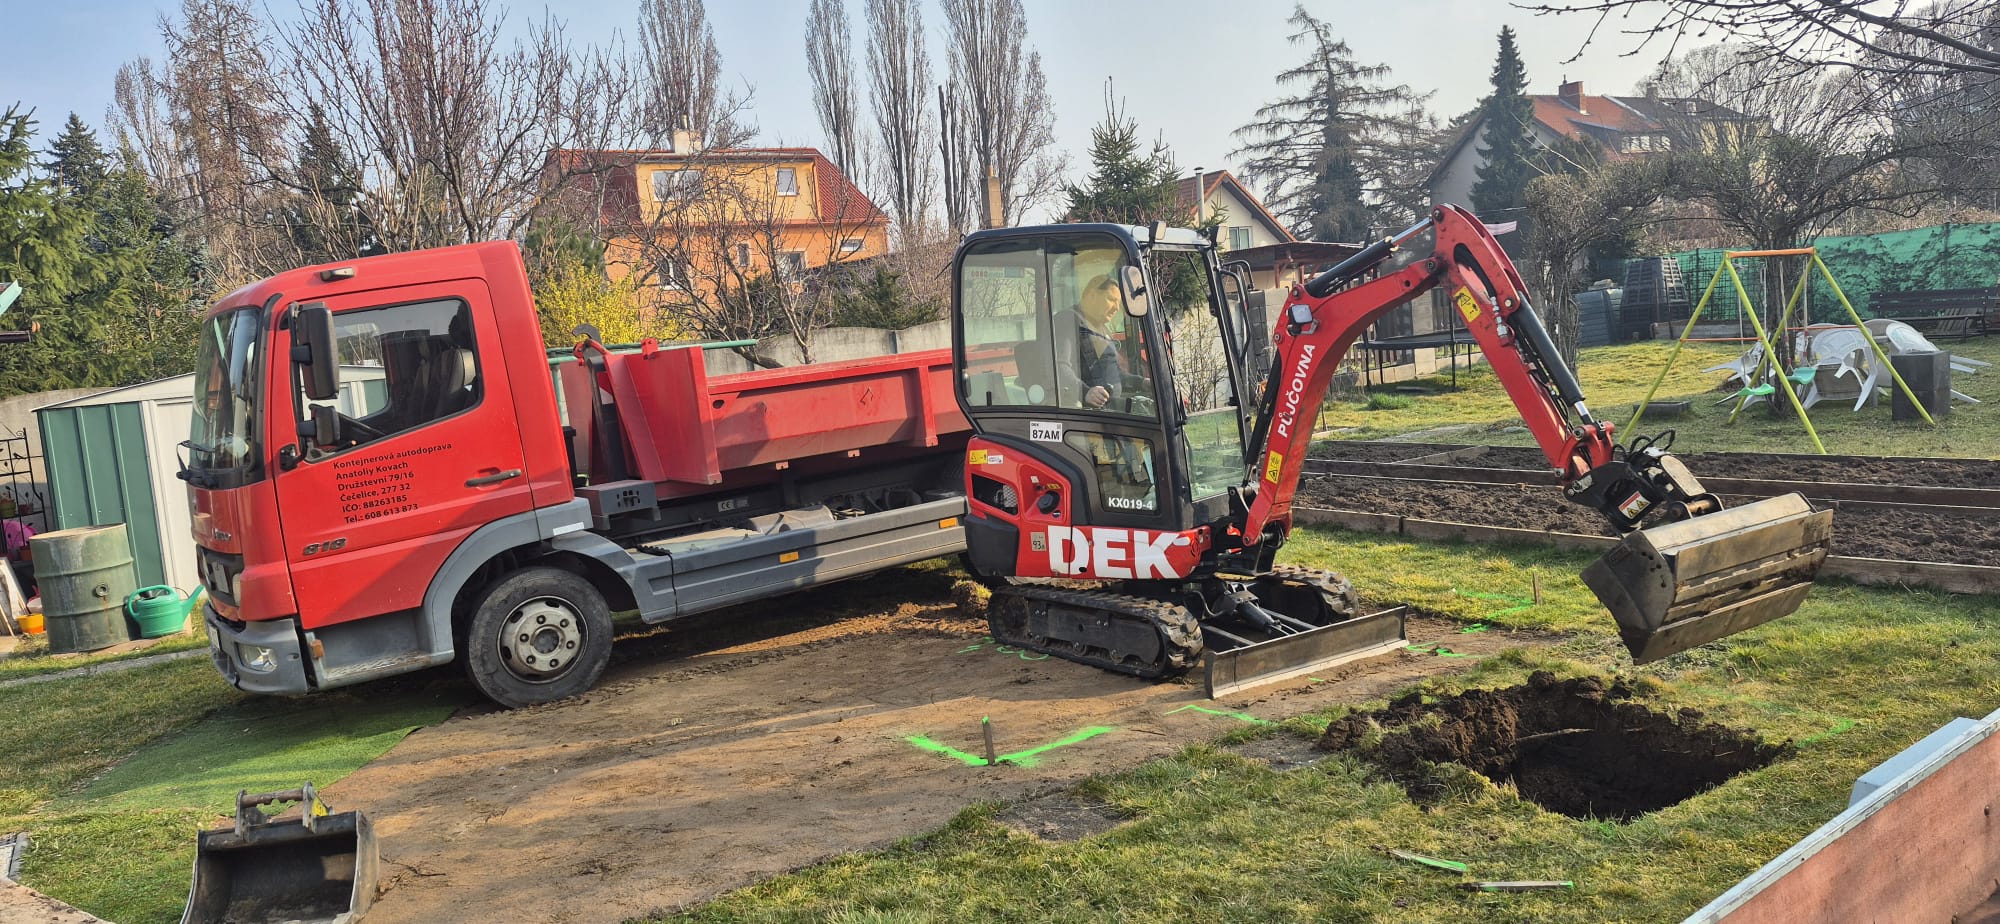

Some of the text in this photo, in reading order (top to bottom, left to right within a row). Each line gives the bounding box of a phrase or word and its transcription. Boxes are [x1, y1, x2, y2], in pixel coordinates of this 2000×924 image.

[1277, 344, 1316, 438] PŮJČOVNA
[1032, 429, 1060, 440] 87AM
[333, 443, 452, 469] Kontejnerová autodoprava
[335, 461, 409, 480] Anatoliy Kovach
[337, 471, 415, 491] Družstevní 79/16
[340, 482, 411, 502] Čečelice, 277 32
[342, 494, 408, 513] IČO: 88263185
[344, 503, 418, 524] Tel.: 608 613 873
[1108, 497, 1153, 511] KX019-4
[303, 537, 346, 556] 818
[1047, 525, 1180, 579] DEK
